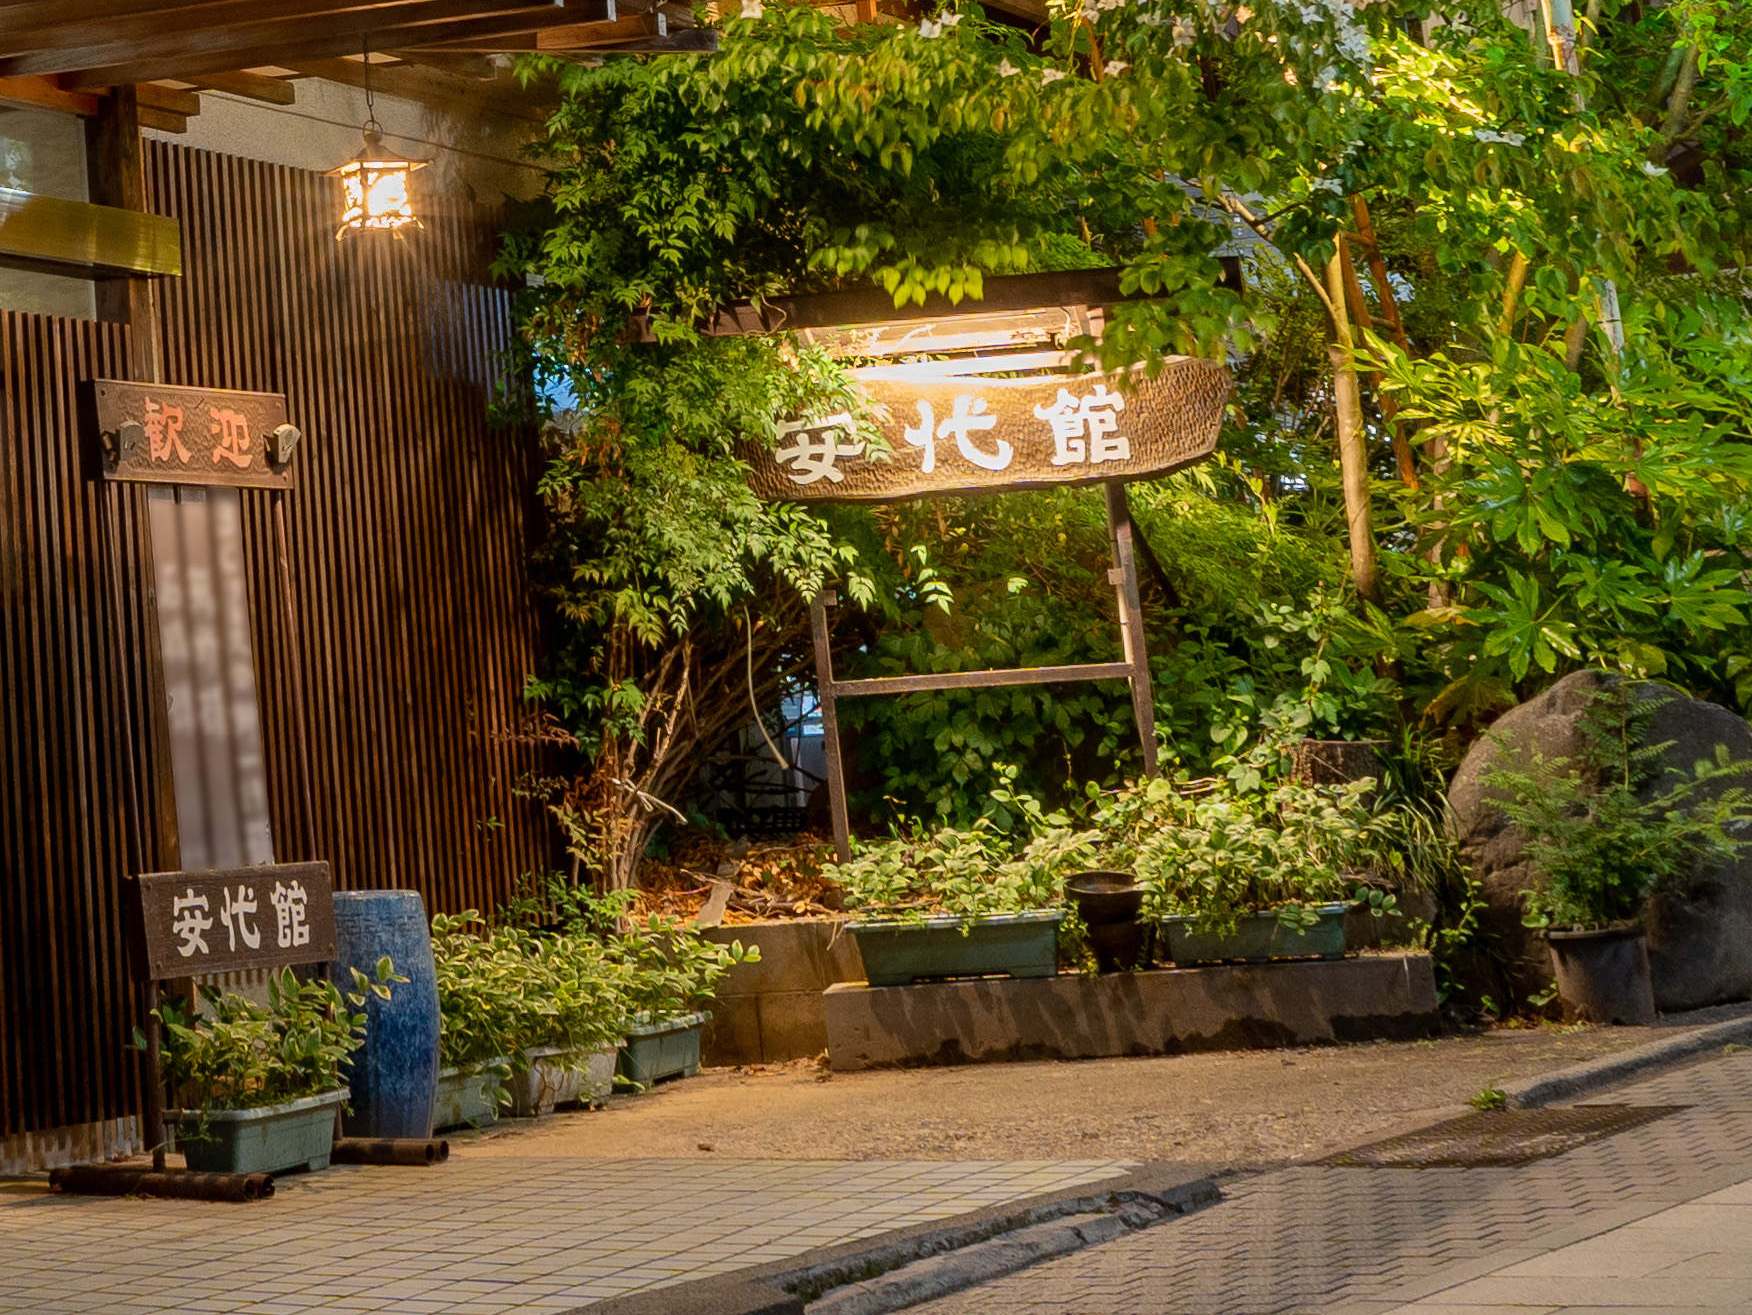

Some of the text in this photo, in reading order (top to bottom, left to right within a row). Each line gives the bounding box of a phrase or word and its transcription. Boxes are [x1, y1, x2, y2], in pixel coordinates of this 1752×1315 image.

[144, 396, 254, 469] 歓迎
[775, 383, 1131, 486] 安代館
[172, 879, 310, 958] 安代館
